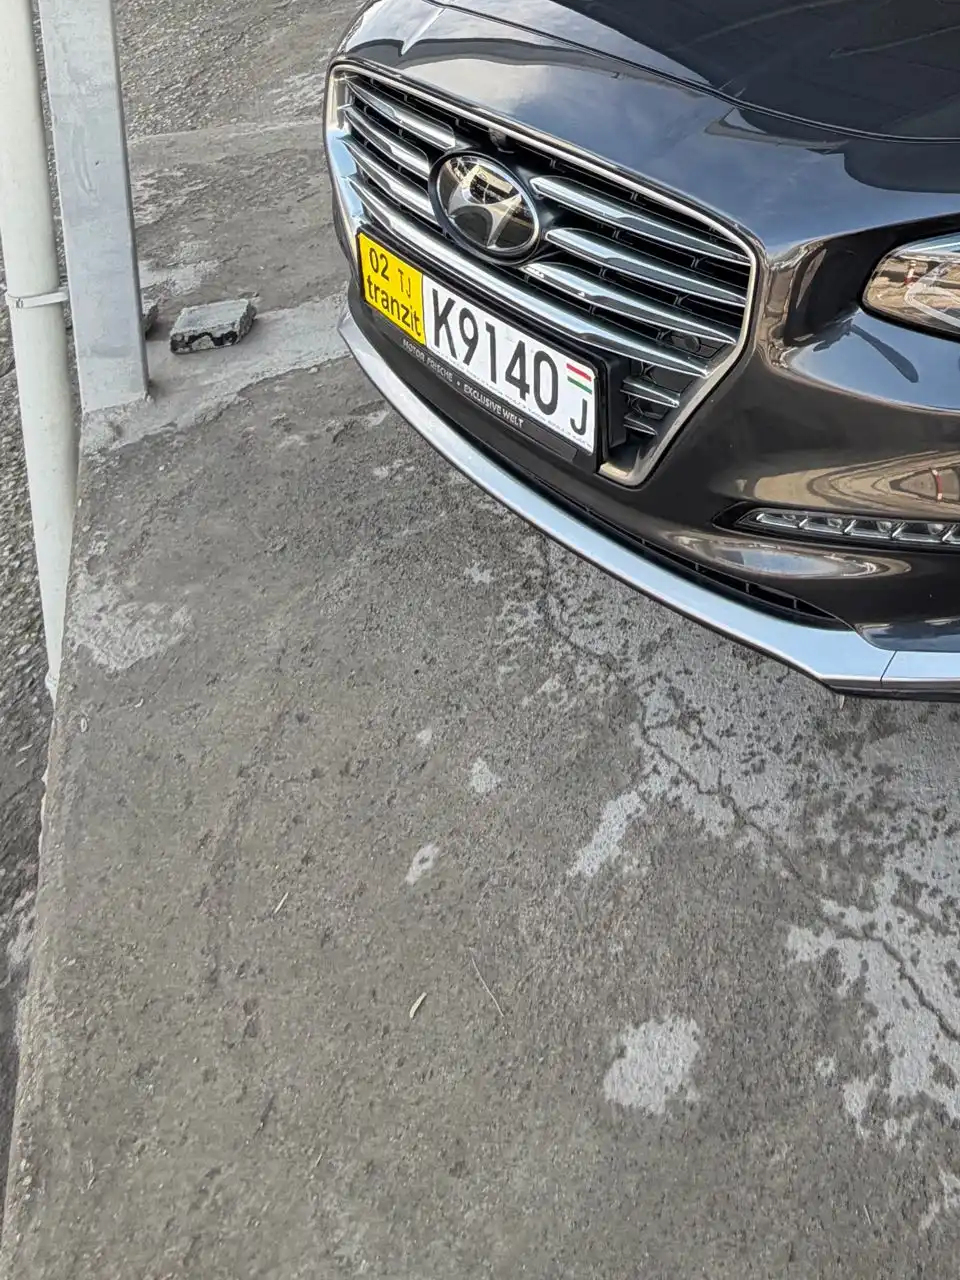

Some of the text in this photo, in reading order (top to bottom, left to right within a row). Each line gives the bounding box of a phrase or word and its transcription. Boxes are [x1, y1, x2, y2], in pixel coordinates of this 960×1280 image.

[369, 247, 411, 299] 02 TJ
[367, 274, 421, 337] tranzit
[432, 288, 588, 436] K9140 J
[463, 383, 501, 414] EXCLUSIVE
[502, 409, 524, 428] WELT
